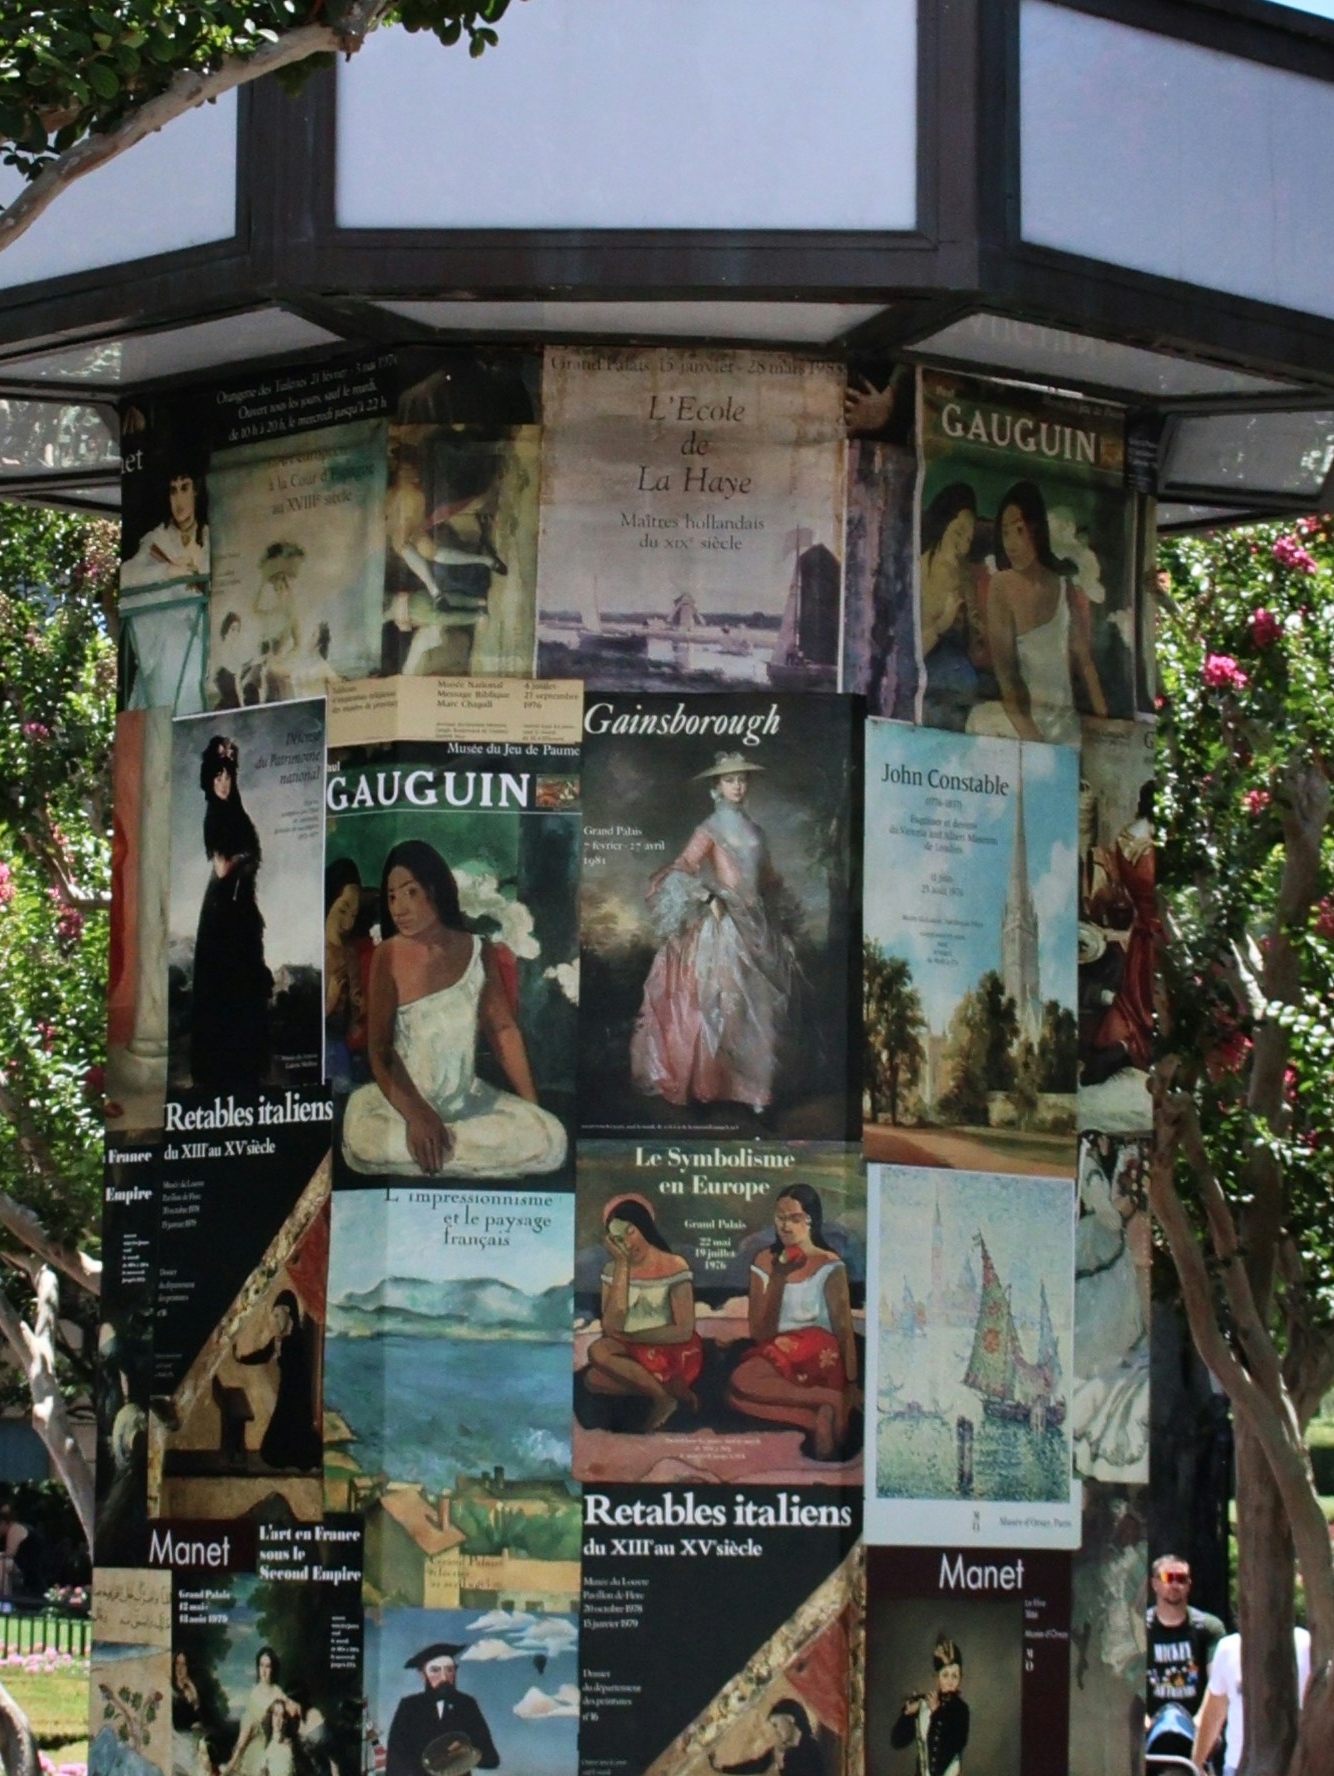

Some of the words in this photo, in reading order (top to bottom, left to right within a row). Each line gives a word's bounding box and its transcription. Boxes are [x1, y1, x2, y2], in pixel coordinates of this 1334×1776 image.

[552, 356, 602, 371] Grand
[648, 394, 747, 423] L'Ecole
[681, 430, 710, 457] de
[941, 403, 1097, 464] GAUGUIN
[637, 465, 670, 493] La
[683, 466, 753, 500] Haye
[620, 511, 680, 530] Maîtres
[685, 513, 765, 531] hollandais
[639, 533, 659, 549] du
[700, 535, 743, 551] siècle
[584, 702, 781, 747] Gainsborough
[447, 742, 484, 755] Musée
[486, 742, 502, 756] du
[503, 742, 523, 757] Jeu
[525, 743, 539, 756] de
[542, 743, 581, 757] Paume
[326, 770, 531, 812] GAUGUIN
[881, 762, 923, 787] John
[927, 768, 1010, 797] Constable
[583, 825, 614, 837] Grand
[616, 825, 643, 837] Palais
[644, 839, 666, 852] avril
[165, 1095, 254, 1132] Retables
[257, 1091, 334, 1125] italiens
[108, 1147, 153, 1165] France
[163, 1143, 179, 1161] du
[208, 1143, 222, 1159] au
[247, 1137, 276, 1156] siècle
[635, 1146, 662, 1168] Le
[667, 1146, 796, 1174] Symbolisme
[105, 1186, 153, 1206] Empire
[658, 1181, 685, 1195] en
[692, 1174, 771, 1202] Europe
[443, 1213, 459, 1225] et
[464, 1203, 480, 1226] le
[485, 1214, 552, 1235] paysage
[683, 1218, 716, 1230] Grand
[717, 1218, 747, 1230] Palais
[444, 1224, 510, 1251] français
[712, 1237, 732, 1247] mai
[707, 1248, 736, 1260] juillet
[583, 1490, 727, 1527] Retables
[733, 1491, 853, 1527] italiens
[258, 1523, 292, 1542] L'art
[294, 1529, 312, 1542] en
[313, 1525, 361, 1543] France
[148, 1528, 231, 1567] Manet
[258, 1548, 290, 1562] sous
[292, 1544, 306, 1562] le
[583, 1537, 607, 1557] du
[654, 1542, 676, 1557] au
[716, 1537, 763, 1557] siècle
[258, 1564, 309, 1582] Second
[312, 1565, 362, 1587] Empire
[938, 1552, 1025, 1591] Manet
[178, 1588, 205, 1600] Grand
[205, 1588, 231, 1600] Palais
